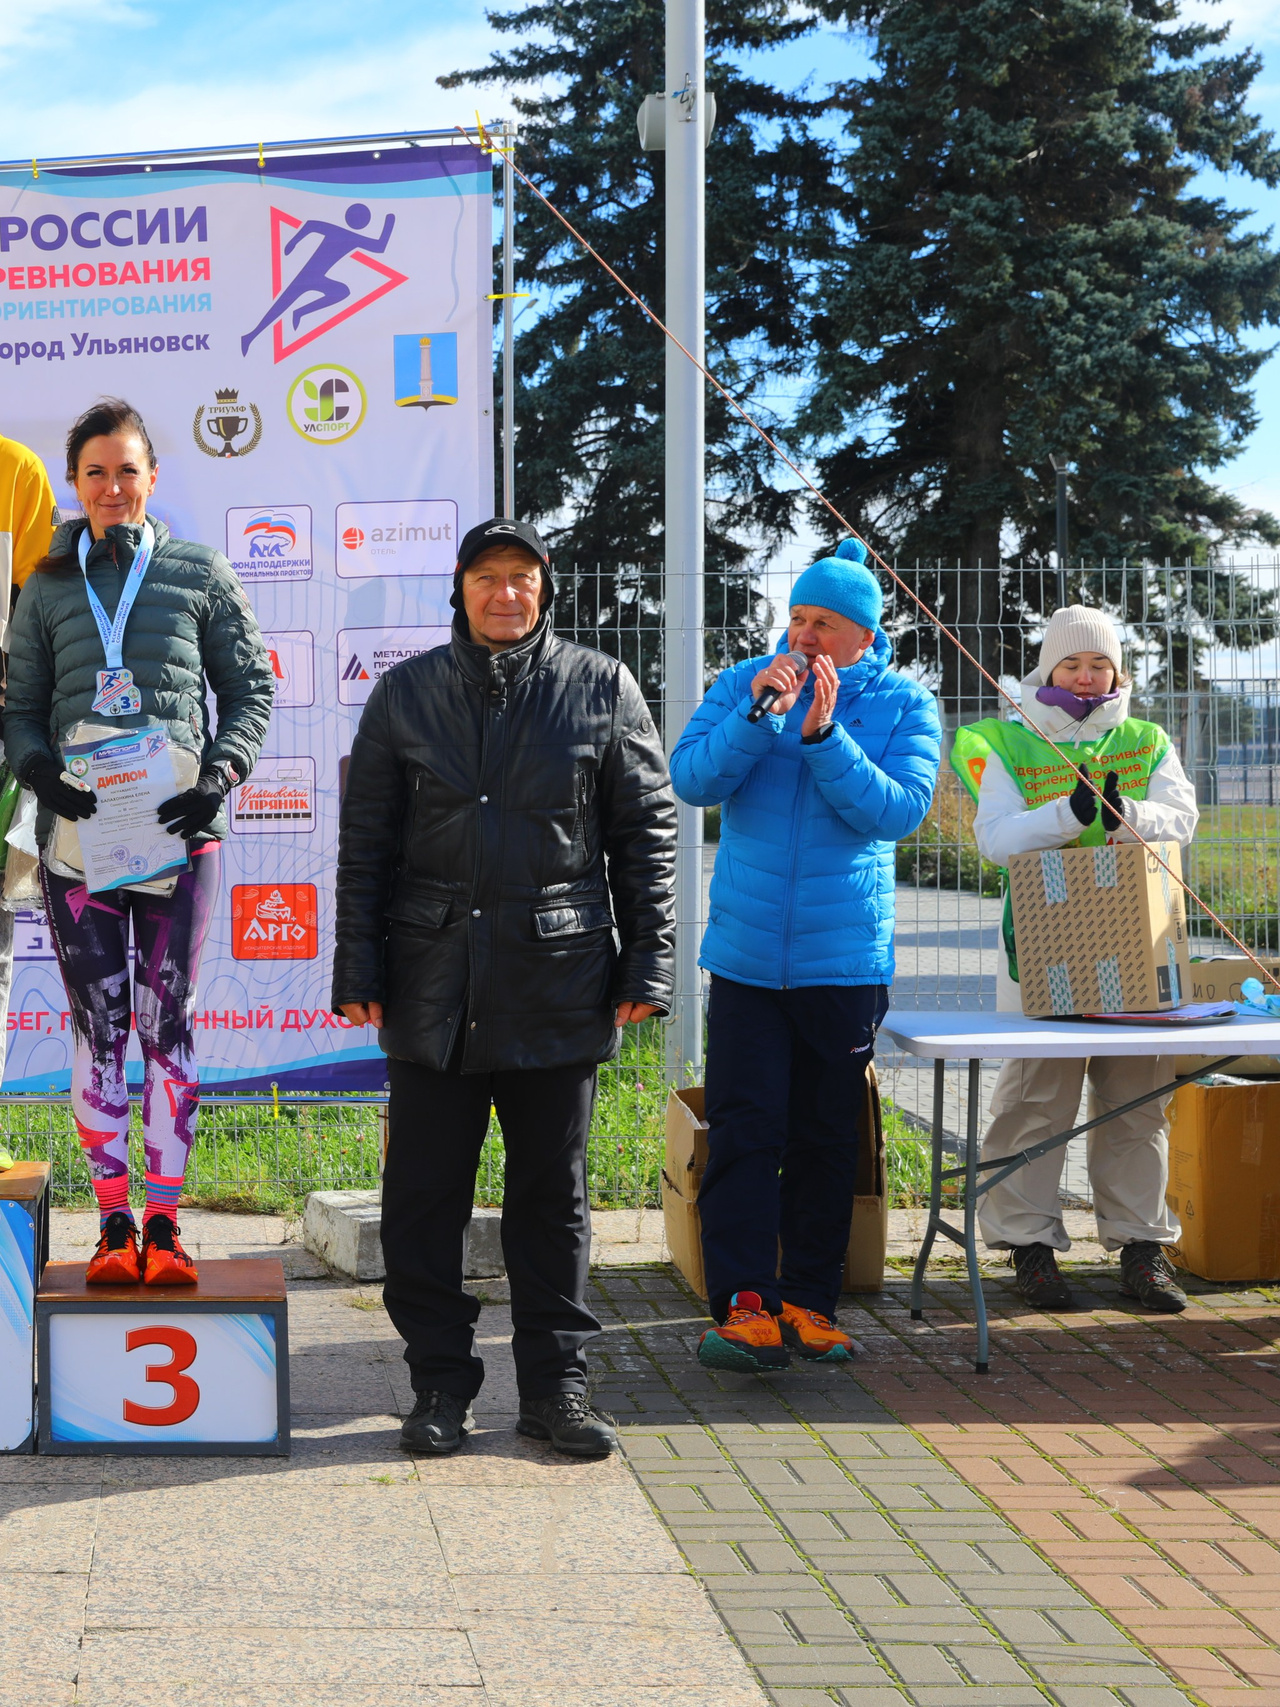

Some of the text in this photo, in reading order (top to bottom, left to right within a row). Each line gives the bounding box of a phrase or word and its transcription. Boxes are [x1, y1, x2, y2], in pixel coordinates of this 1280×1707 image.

[69, 331, 211, 357] Ульяновск
[208, 405, 247, 415] ТРИУМФ
[303, 422, 351, 433] УЛСПОРТ
[370, 521, 452, 543] azimut
[370, 547, 397, 556] ОТЕЛЬ
[231, 559, 311, 571] ФОНД ПОДДЕРЖКИ
[280, 568, 312, 577] ПРОЕКТОВ
[120, 695, 131, 710] 3
[98, 744, 139, 757] МИНСПОРТ
[97, 769, 149, 790] ДИПЛОМ
[249, 799, 310, 811] ПРЯНИК
[122, 1323, 201, 1428] 3
